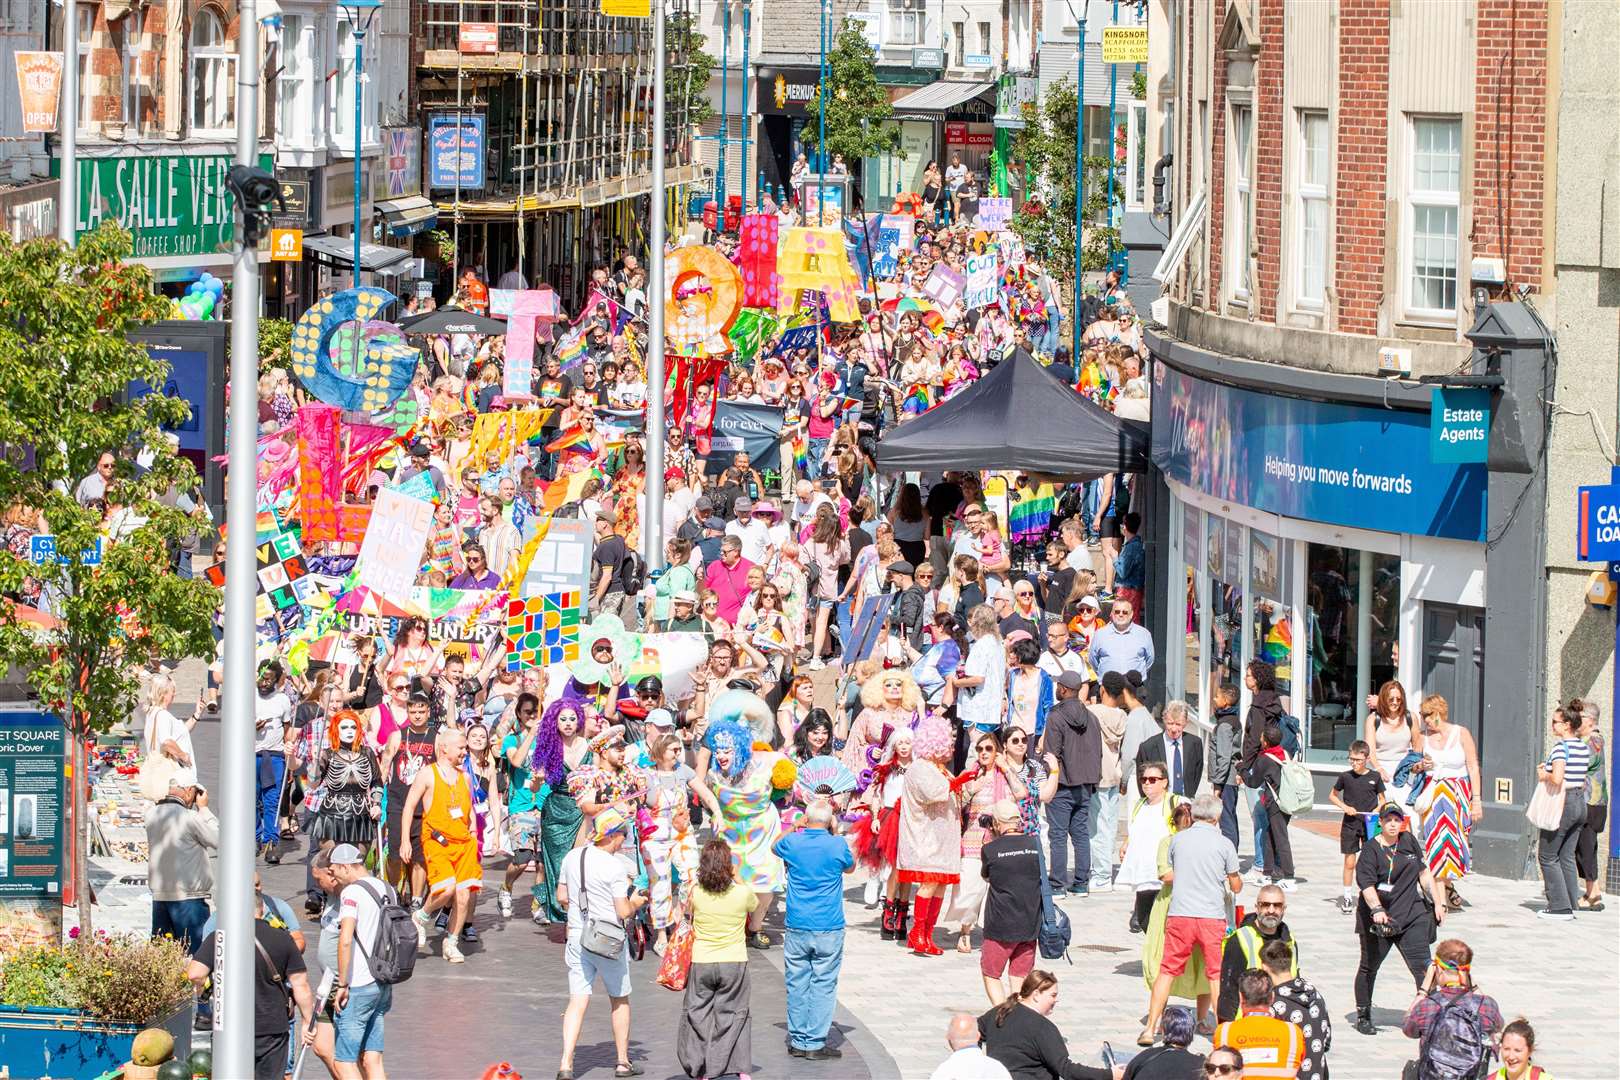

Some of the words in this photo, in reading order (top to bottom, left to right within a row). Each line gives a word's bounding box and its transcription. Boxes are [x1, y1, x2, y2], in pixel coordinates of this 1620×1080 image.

[785, 84, 815, 99] MERKUR
[27, 112, 53, 125] OPEN
[75, 160, 101, 231] LA
[115, 157, 178, 229] SALLE
[136, 236, 168, 255] COFFEE
[174, 234, 197, 253] SHOP
[720, 417, 737, 429] for
[1443, 407, 1483, 423] Estate
[1439, 426, 1485, 443] Agents
[1265, 455, 1296, 482] Helping
[1297, 466, 1317, 484] you
[1318, 469, 1349, 488] move
[1352, 468, 1412, 494] forwards
[1597, 505, 1620, 524] CA
[13, 730, 60, 741] SQUARE
[17, 743, 45, 752] Dover
